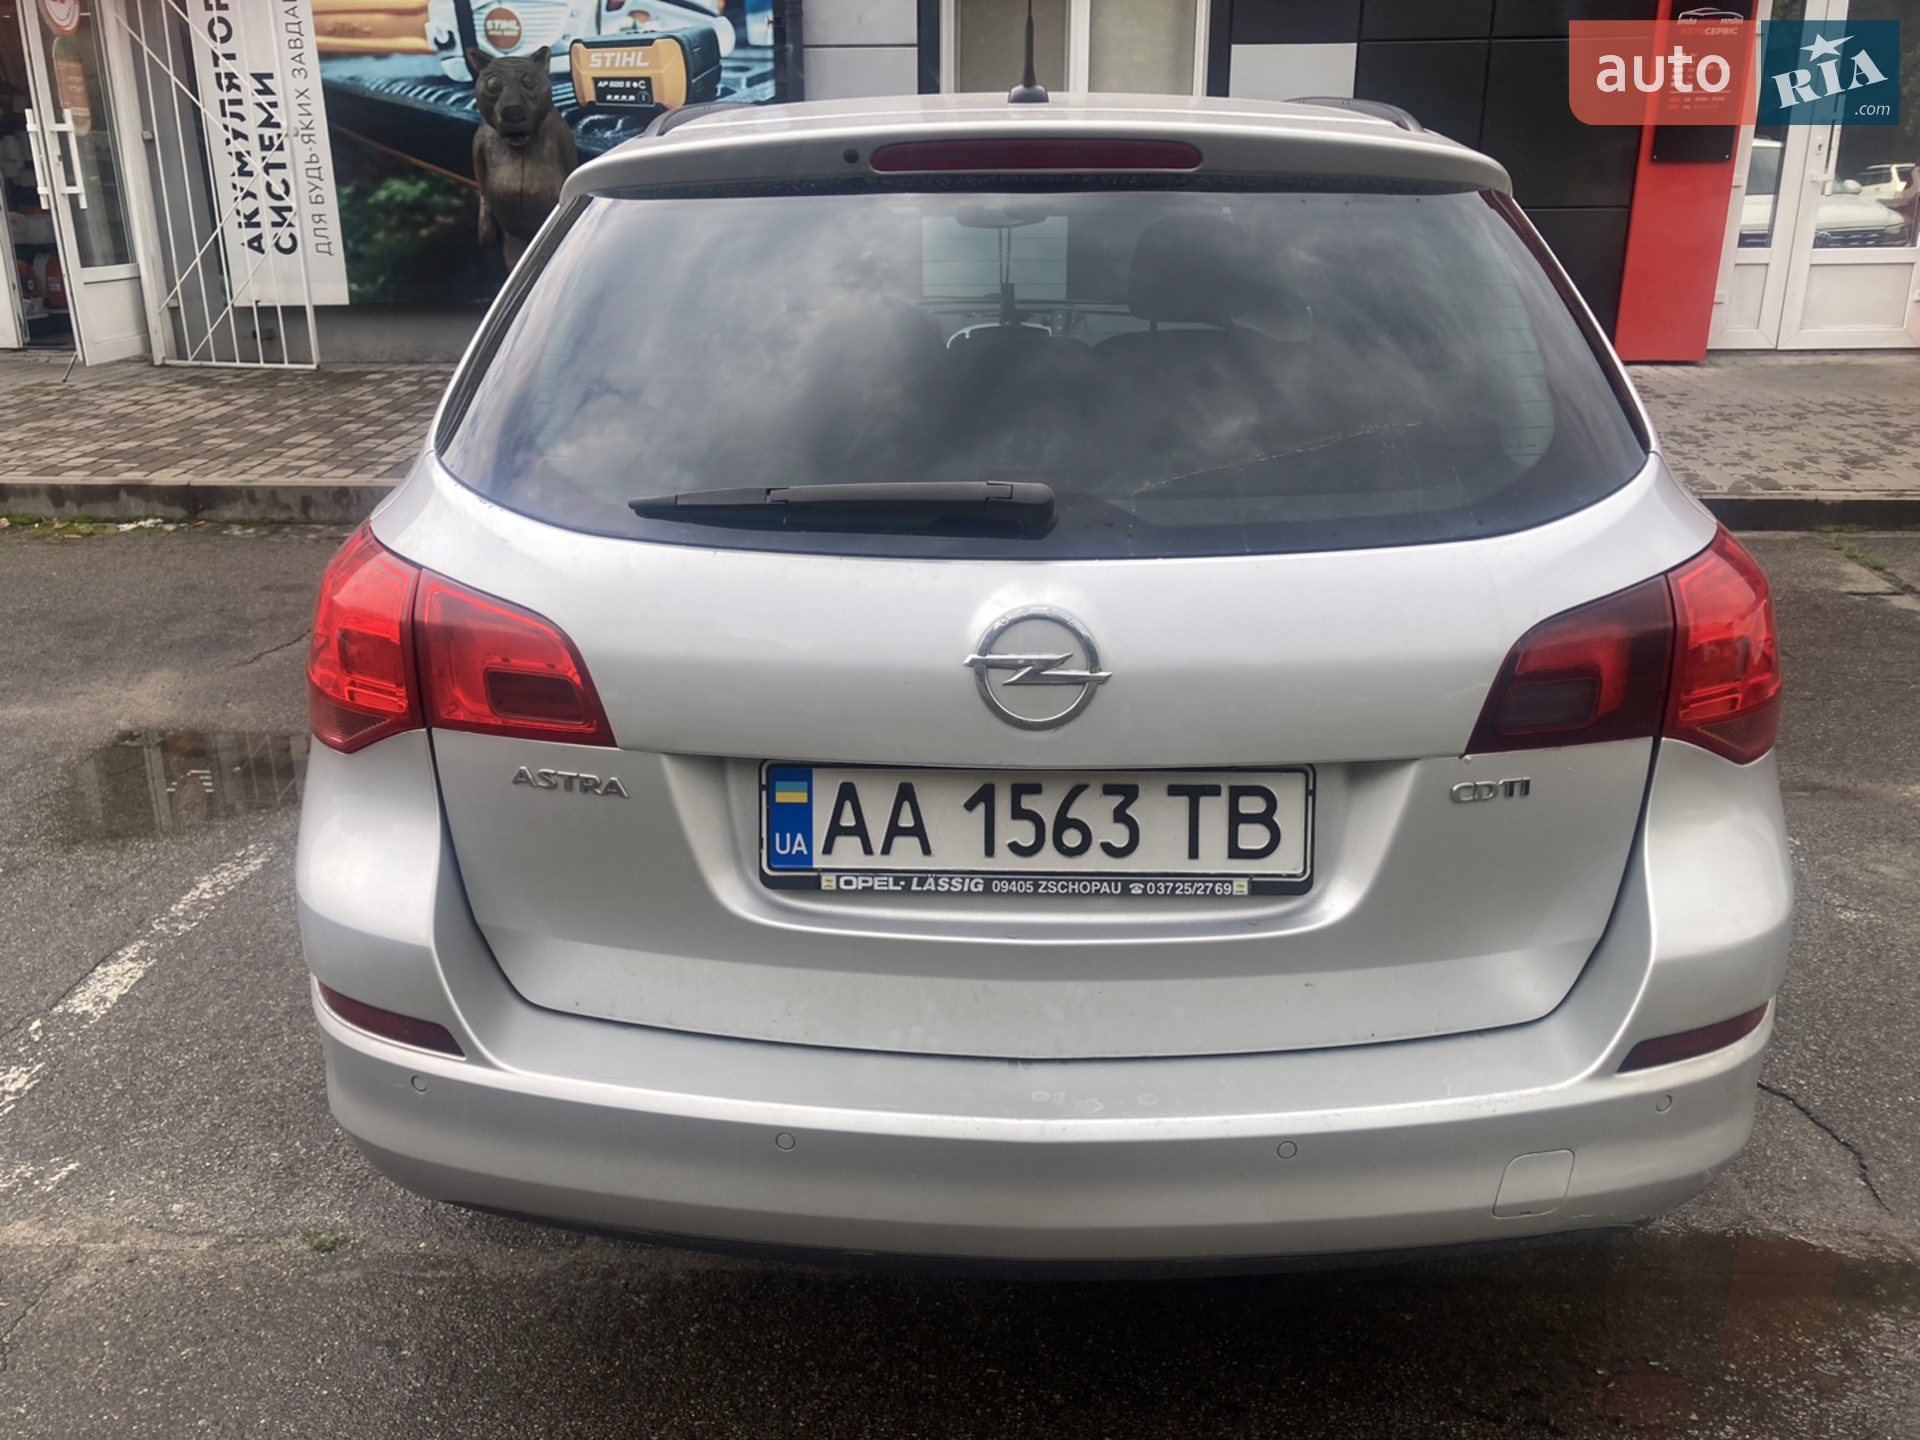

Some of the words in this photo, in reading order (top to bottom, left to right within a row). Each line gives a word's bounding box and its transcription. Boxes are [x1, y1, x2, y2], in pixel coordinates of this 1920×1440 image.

[283, 0, 308, 79] ЗАВДА
[486, 19, 520, 30] STIHL
[589, 51, 650, 68] STIHL
[294, 88, 325, 205] БУДЬ-ЯКИХ
[249, 72, 298, 255] СИСТЕМИ
[311, 213, 334, 256] ДЛЯ
[511, 766, 629, 798] ASTRA
[1450, 777, 1530, 803] CDTI
[821, 782, 932, 856] AA
[963, 783, 1140, 858] 1563
[1167, 784, 1281, 859] TB
[775, 832, 808, 855] UA
[911, 874, 985, 892] LÄSSIG
[992, 880, 1034, 893] 09405
[1037, 880, 1122, 894] ZSCHOPAU
[1146, 882, 1232, 896] 03725/2769
